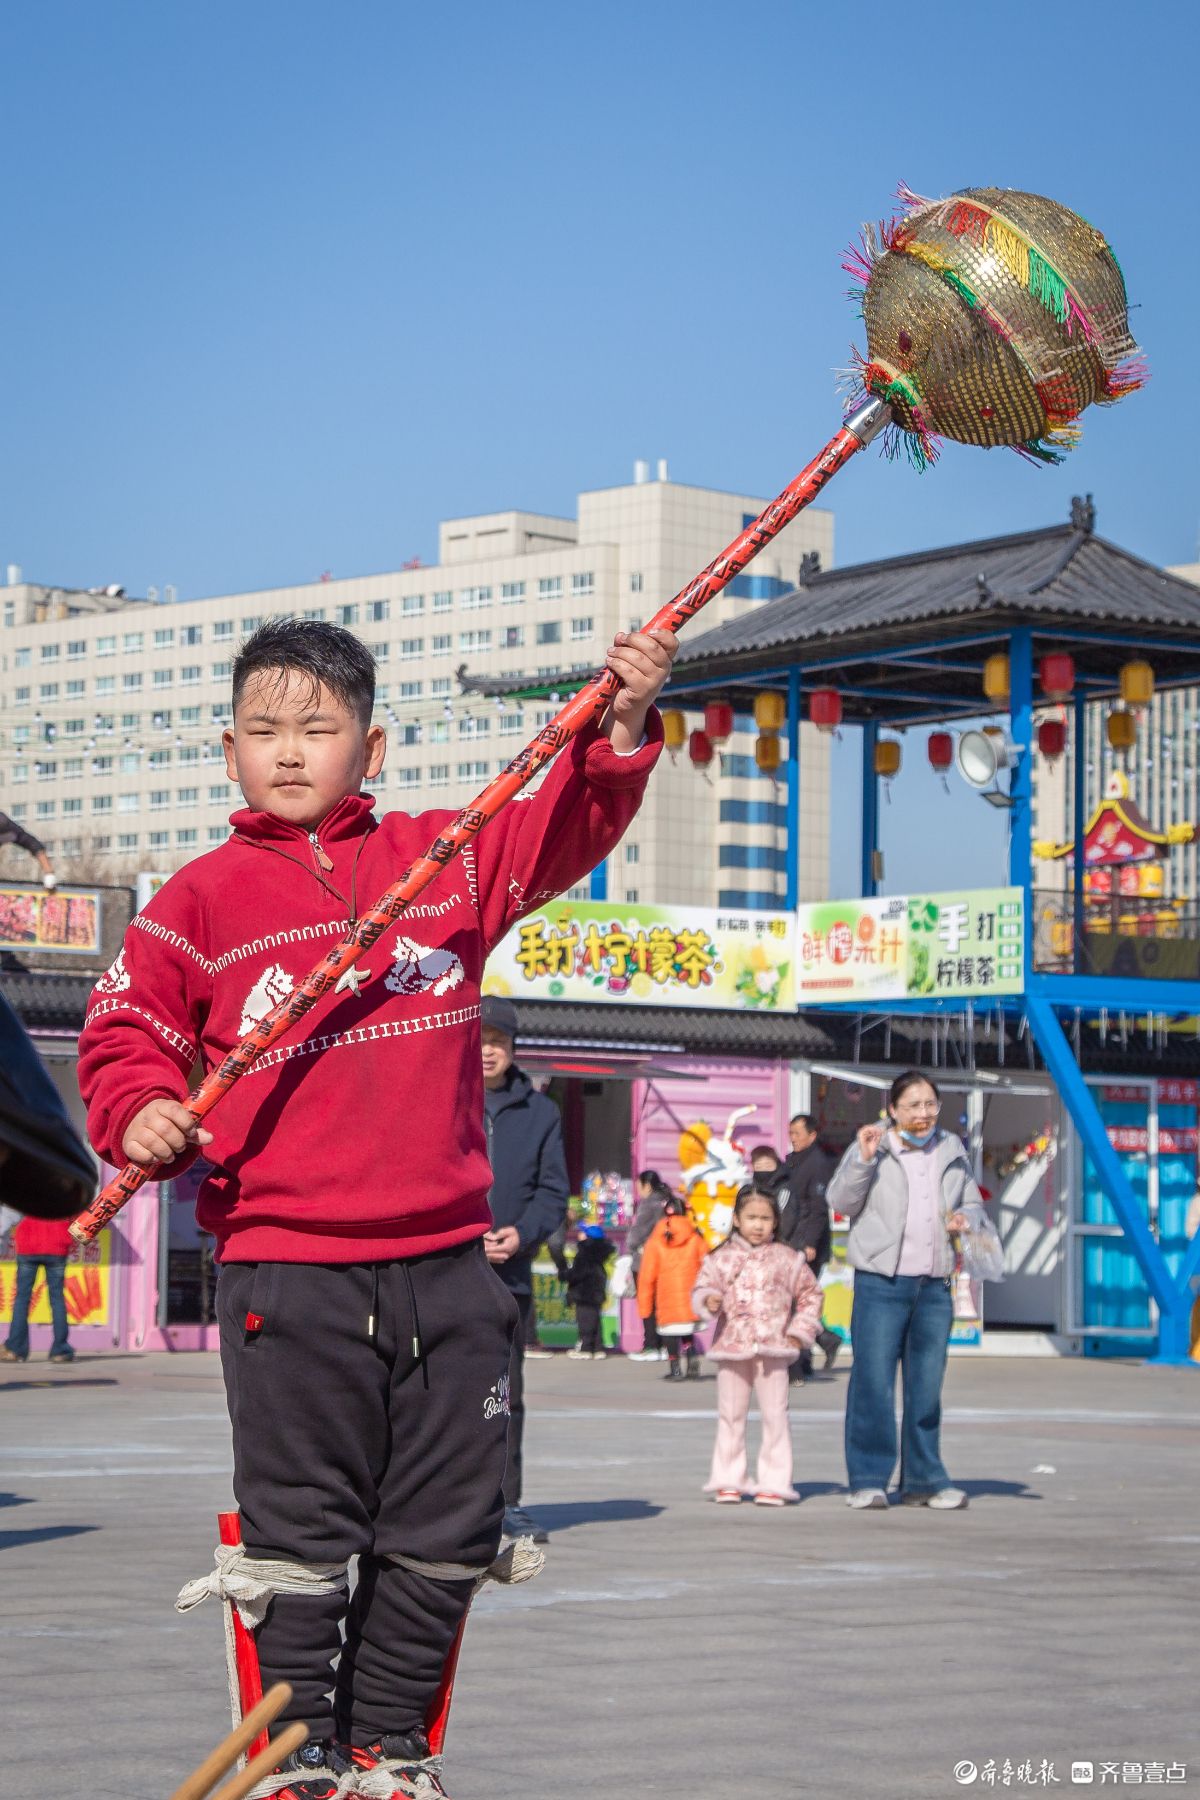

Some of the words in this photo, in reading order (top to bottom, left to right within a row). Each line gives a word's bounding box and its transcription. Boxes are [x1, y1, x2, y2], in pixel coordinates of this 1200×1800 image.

[515, 919, 713, 988] 手打柠檬茶
[936, 955, 996, 989] 柠檬茶
